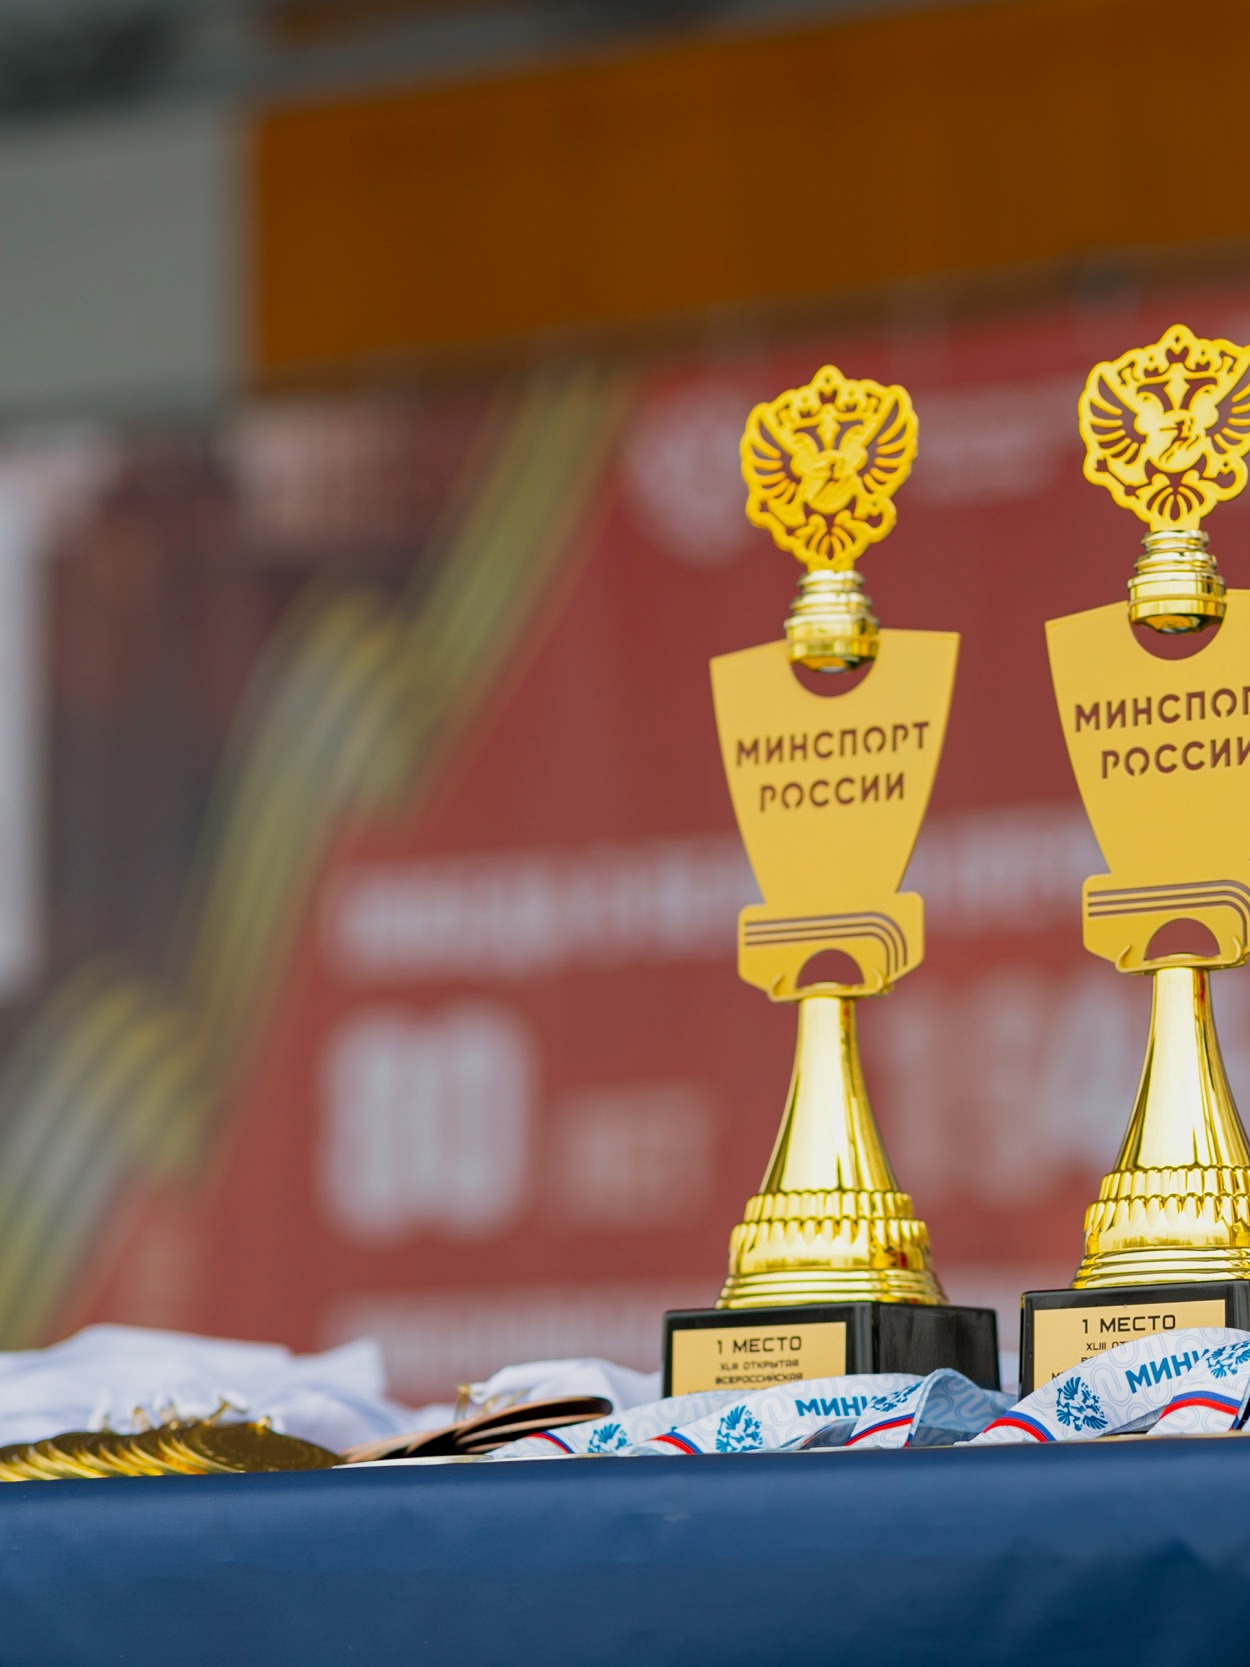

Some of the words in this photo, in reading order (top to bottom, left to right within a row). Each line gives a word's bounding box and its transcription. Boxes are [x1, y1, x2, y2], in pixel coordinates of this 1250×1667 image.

[734, 721, 930, 768] МИНСПОРТ
[759, 772, 905, 813] РОССИИ
[1082, 1318, 1088, 1334] 1
[1100, 1314, 1176, 1333] МЕСТО
[717, 1339, 723, 1355] 1
[732, 1336, 802, 1354] МЕСТО
